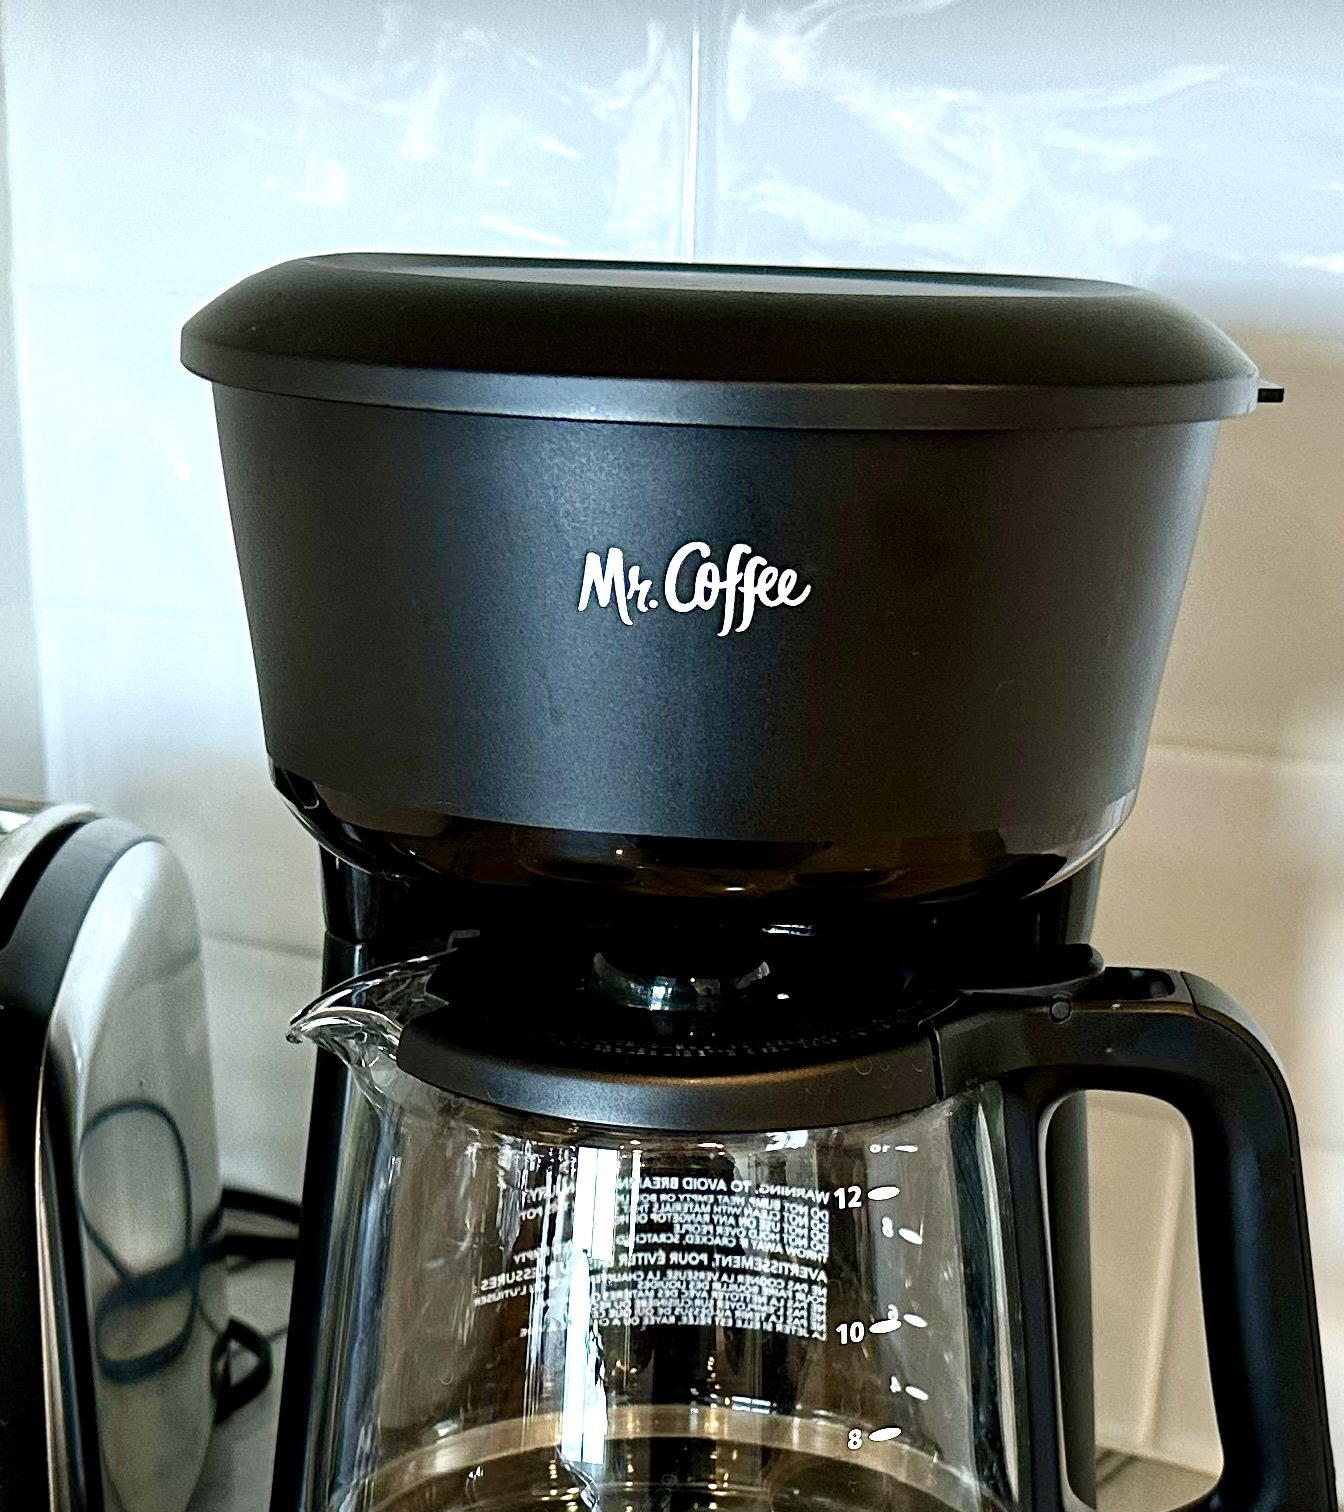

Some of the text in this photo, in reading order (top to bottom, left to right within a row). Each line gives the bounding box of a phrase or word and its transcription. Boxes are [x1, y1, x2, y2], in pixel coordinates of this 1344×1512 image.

[578, 541, 812, 637] Mr. Coffee
[833, 1186, 862, 1209] 12
[836, 1321, 865, 1345] 10
[847, 1428, 863, 1450] 8
